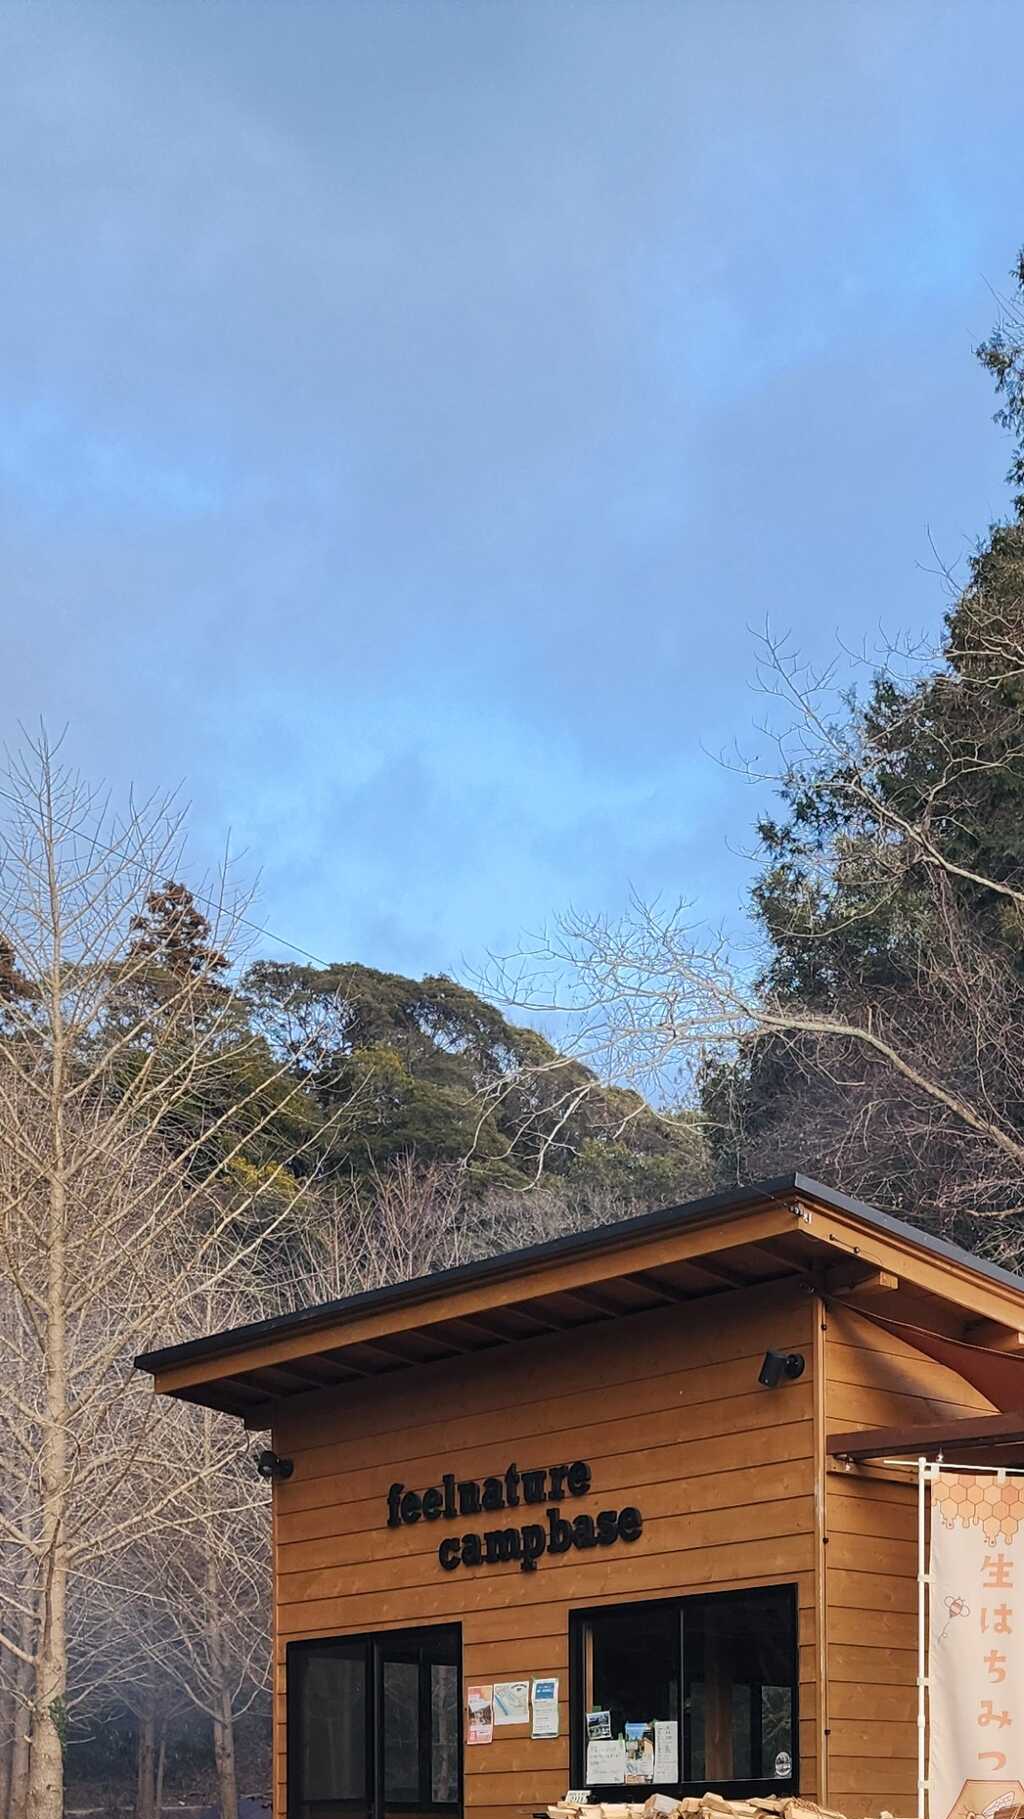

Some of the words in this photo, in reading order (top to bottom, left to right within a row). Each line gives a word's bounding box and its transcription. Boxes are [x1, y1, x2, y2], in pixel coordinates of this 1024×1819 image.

[387, 1461, 592, 1528] feelnature
[438, 1507, 643, 1572] campbase
[977, 1553, 1014, 1771] 生はちみつ
